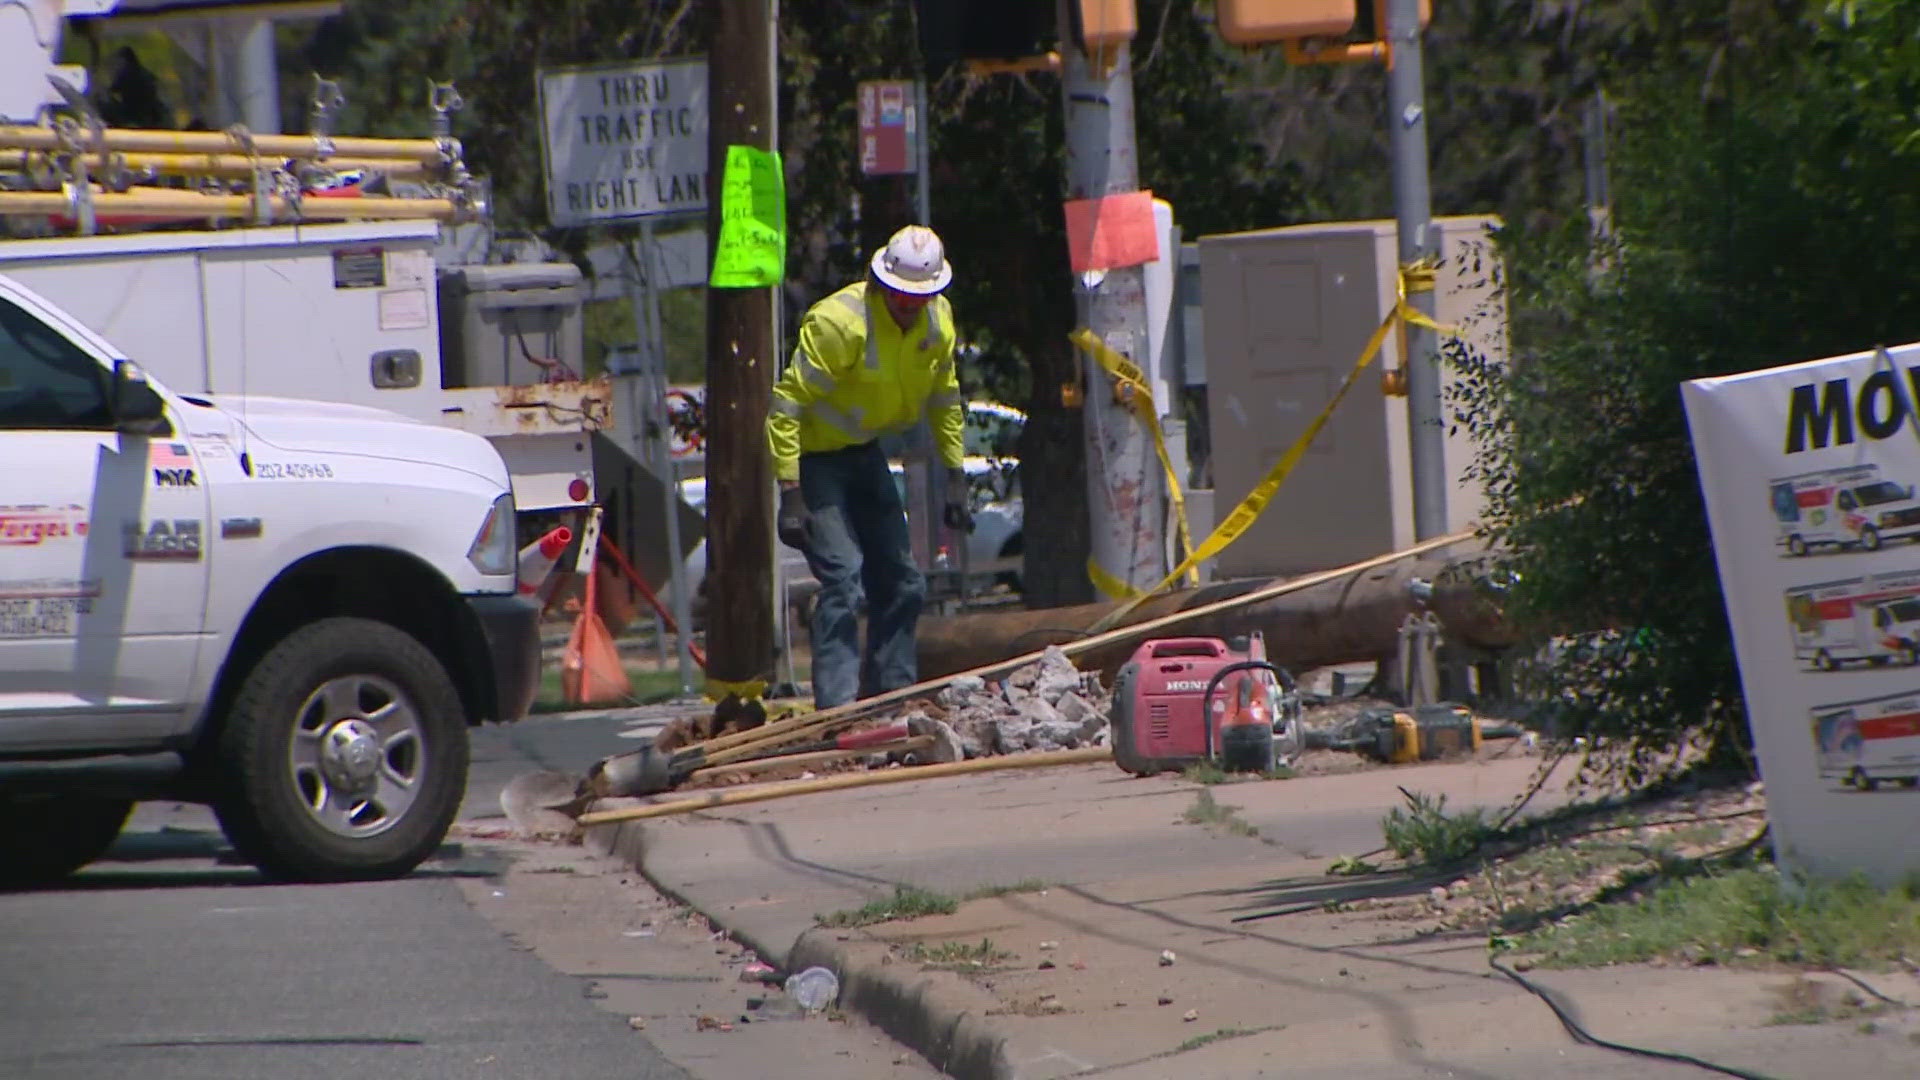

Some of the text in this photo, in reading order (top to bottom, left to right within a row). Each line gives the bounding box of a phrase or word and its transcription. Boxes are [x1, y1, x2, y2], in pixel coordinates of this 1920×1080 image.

[599, 73, 668, 106] THRU
[580, 107, 691, 144] TRAFFIC
[621, 146, 655, 169] USE
[567, 173, 709, 210] RIGHT LAN
[153, 468, 197, 486] MYR
